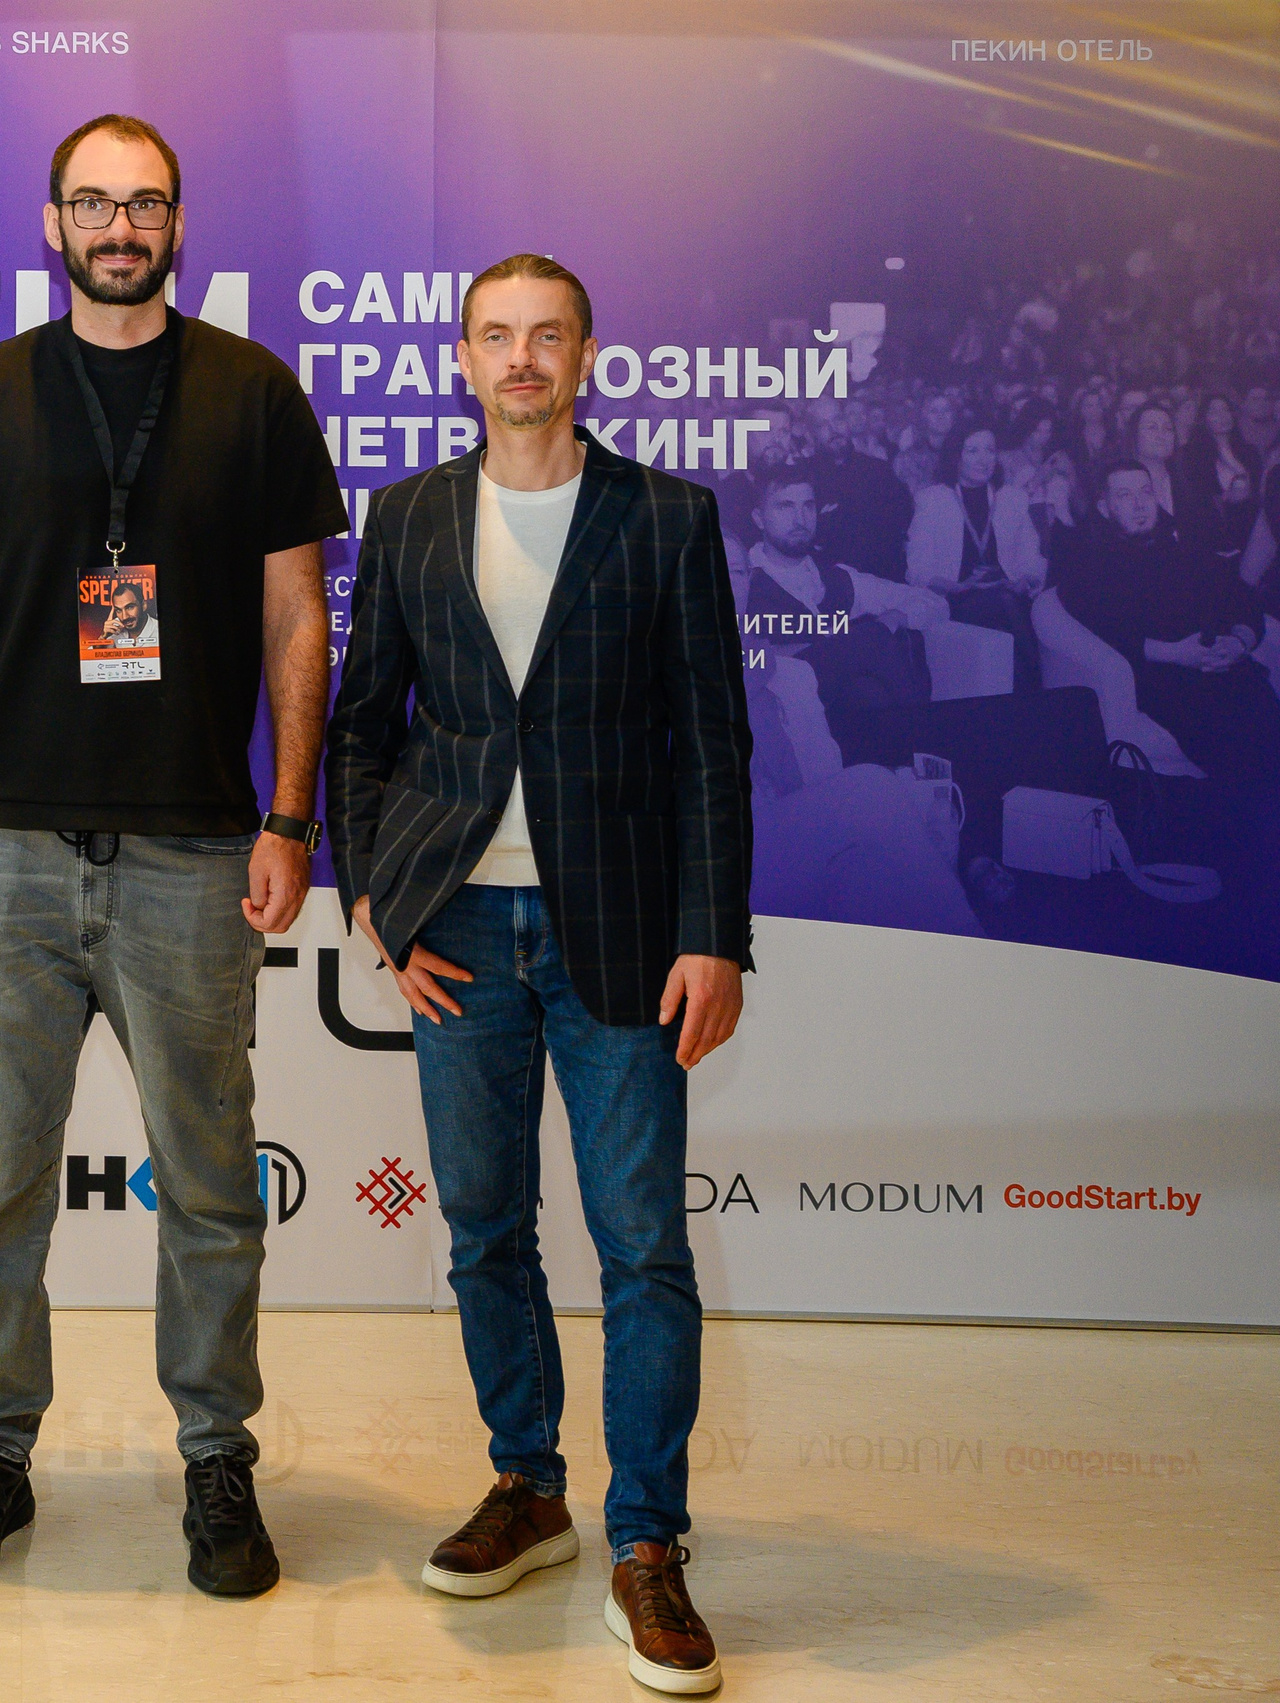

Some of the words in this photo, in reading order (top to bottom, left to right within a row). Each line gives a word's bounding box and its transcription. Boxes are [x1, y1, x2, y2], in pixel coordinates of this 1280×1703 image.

[11, 31, 129, 55] SHARKS
[951, 39, 1046, 62] ПЕКИН
[1056, 39, 1153, 62] ОТЕЛЬ
[298, 329, 848, 399] ГРАНОЗНЫЙ
[323, 416, 770, 470] ЕТВКИНГ
[80, 578, 154, 606] SPEAR
[736, 610, 849, 635] ИТЕЛЕЙ
[799, 1181, 983, 1213] MODUM
[1004, 1183, 1202, 1217] GoodStart.by
